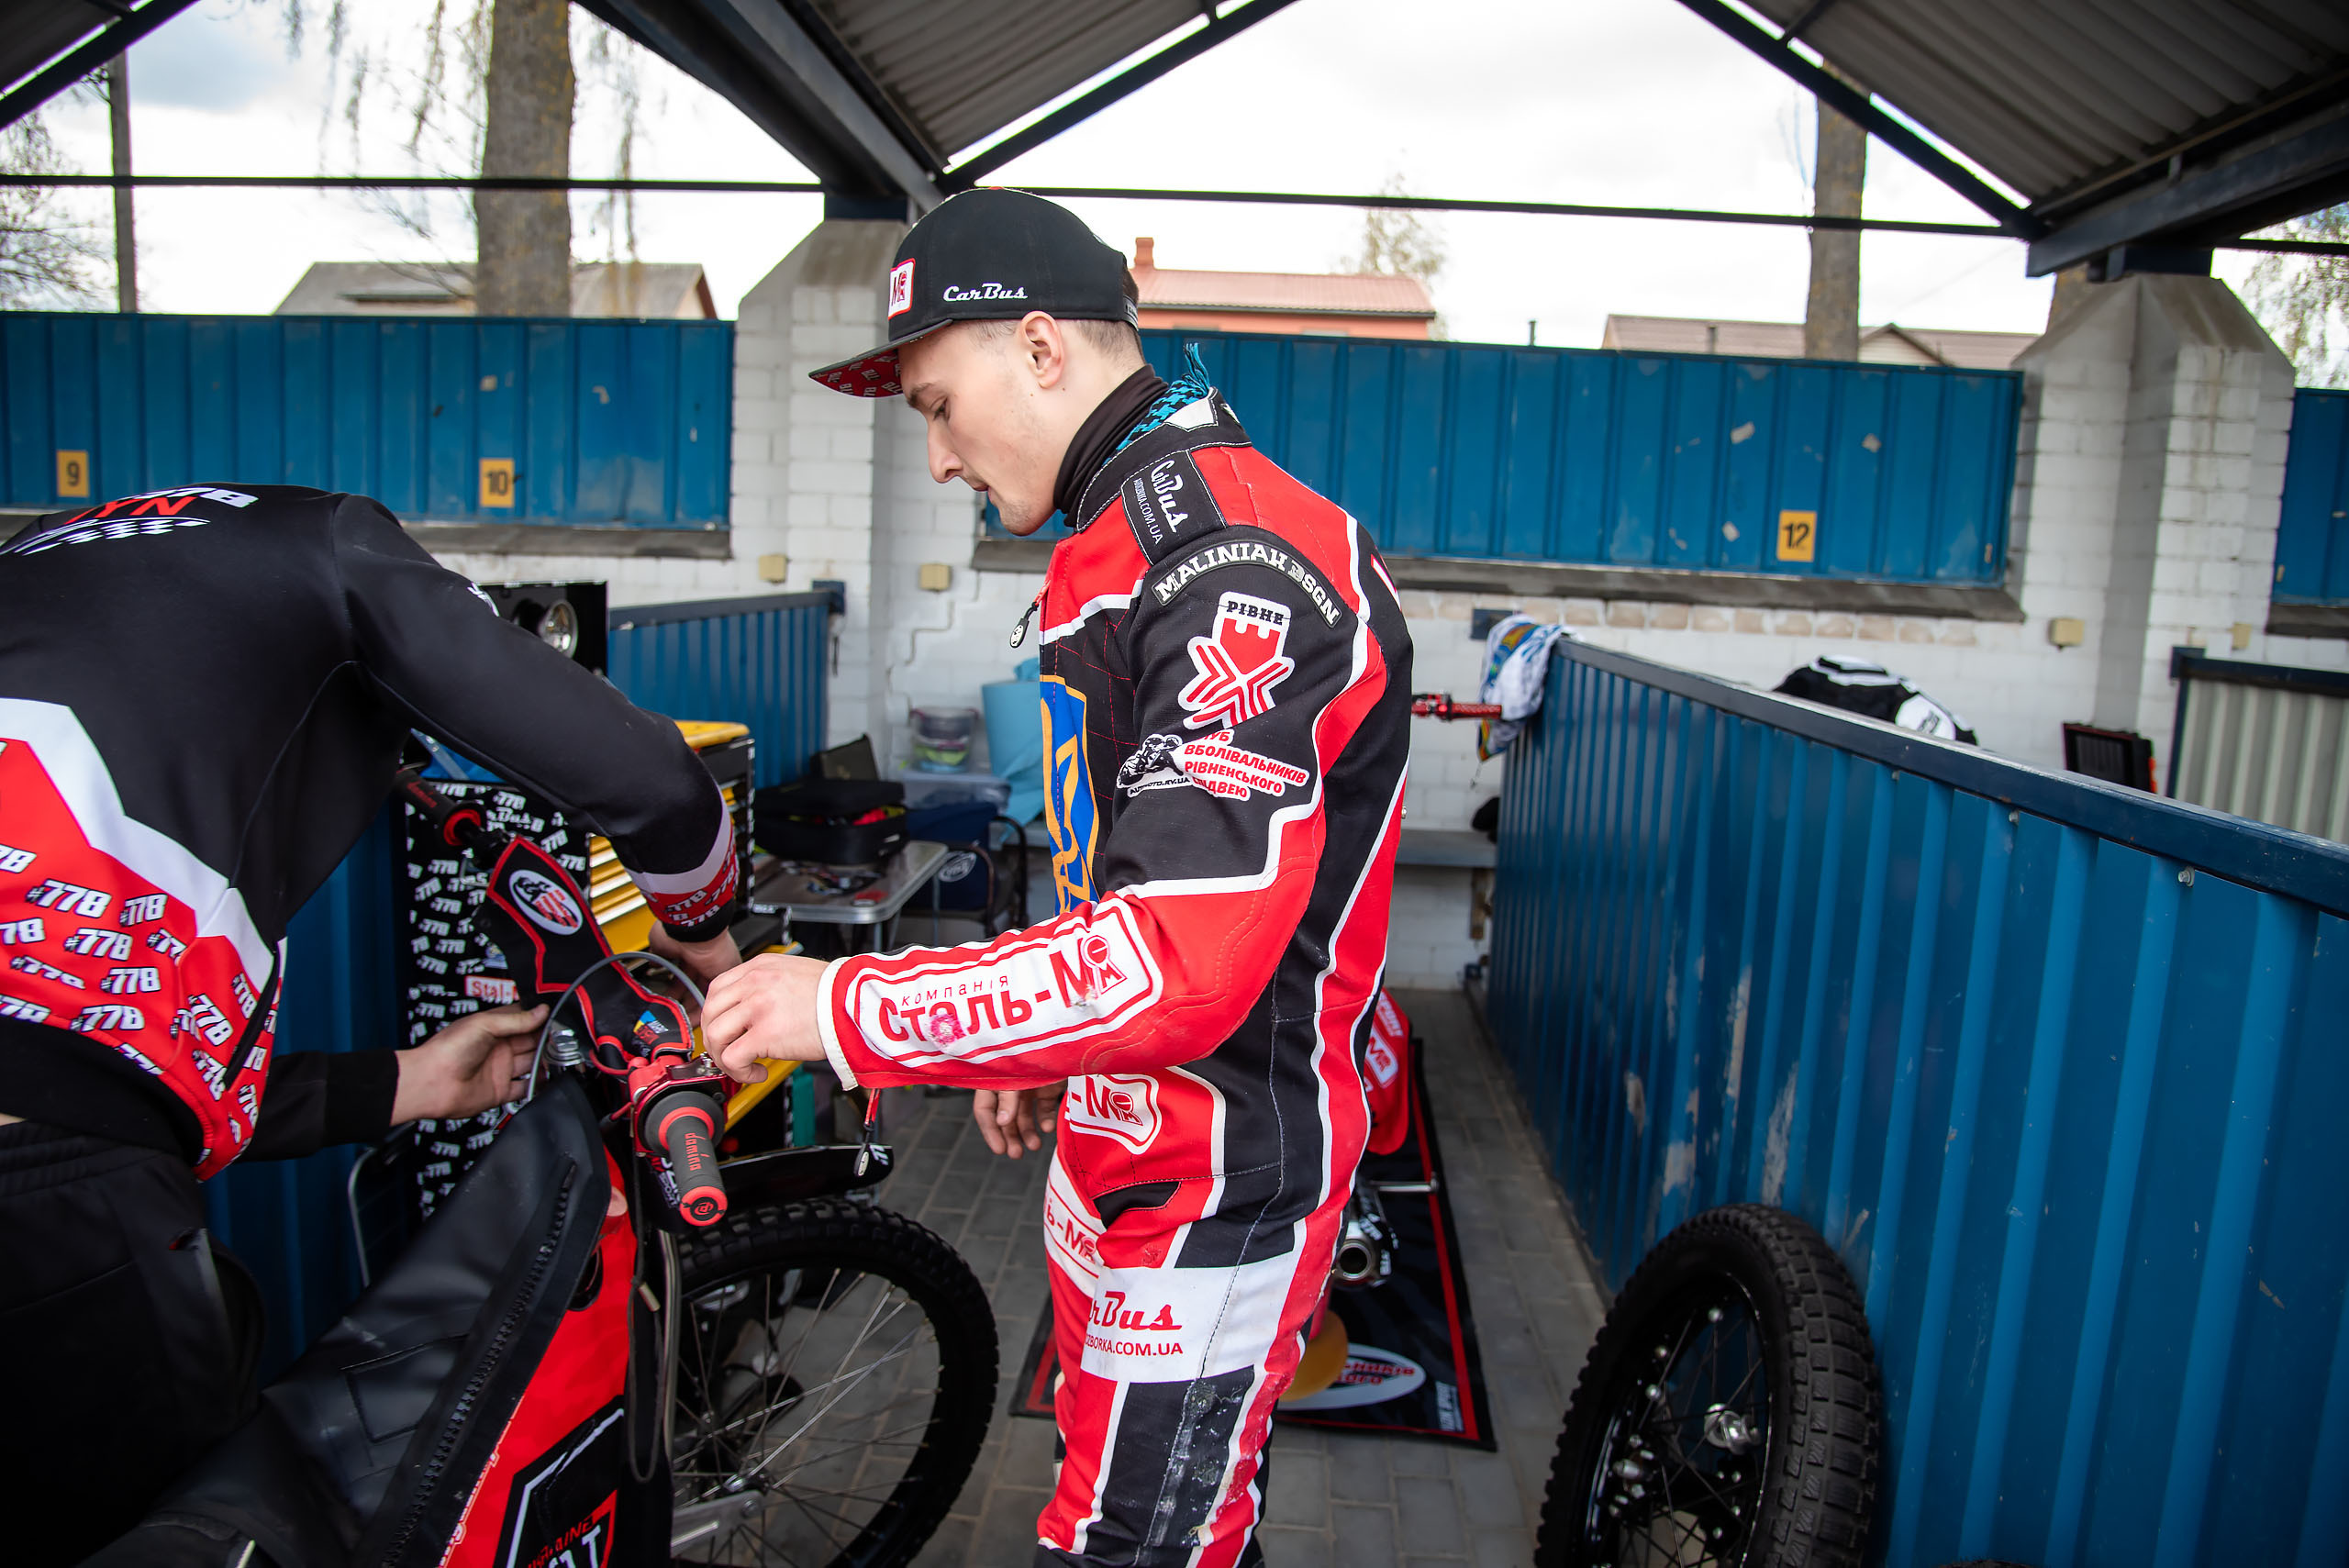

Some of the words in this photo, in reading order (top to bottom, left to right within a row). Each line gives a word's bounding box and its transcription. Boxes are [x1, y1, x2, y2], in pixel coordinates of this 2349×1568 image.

[942, 282, 1028, 302] CarBus
[67, 461, 80, 486] 9
[485, 469, 508, 495] 10
[1783, 522, 1809, 550] 12
[1227, 600, 1285, 626] РІВНЕ
[1184, 744, 1307, 784] ВБОЛІВАЛЬНИКІВ
[1184, 761, 1283, 794] РІВНЕНСЬКОГО
[25, 878, 112, 919] #778
[63, 928, 133, 962] #778
[99, 966, 162, 995] #778
[471, 980, 519, 1000] Stal-
[901, 974, 1009, 1007] компанія
[71, 1004, 145, 1033] #778
[187, 992, 234, 1047] #778
[1089, 1290, 1183, 1331] rBus
